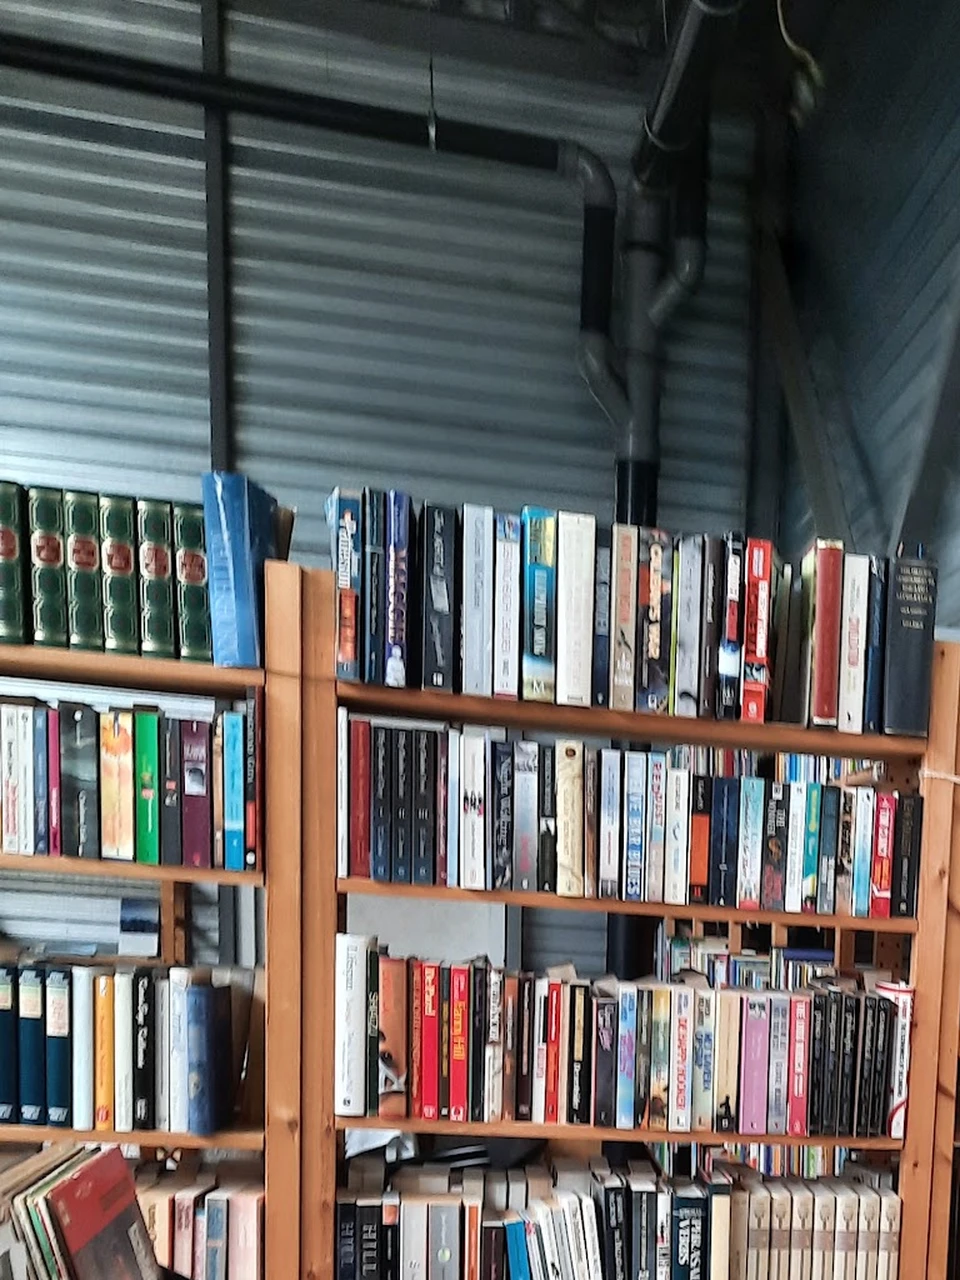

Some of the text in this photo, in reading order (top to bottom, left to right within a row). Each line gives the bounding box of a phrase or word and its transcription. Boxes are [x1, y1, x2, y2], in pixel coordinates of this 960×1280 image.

[627, 850, 641, 896] BLUES
[341, 1222, 354, 1268] HILL
[362, 1223, 378, 1277] HILL
[678, 1218, 690, 1265] VERBS
